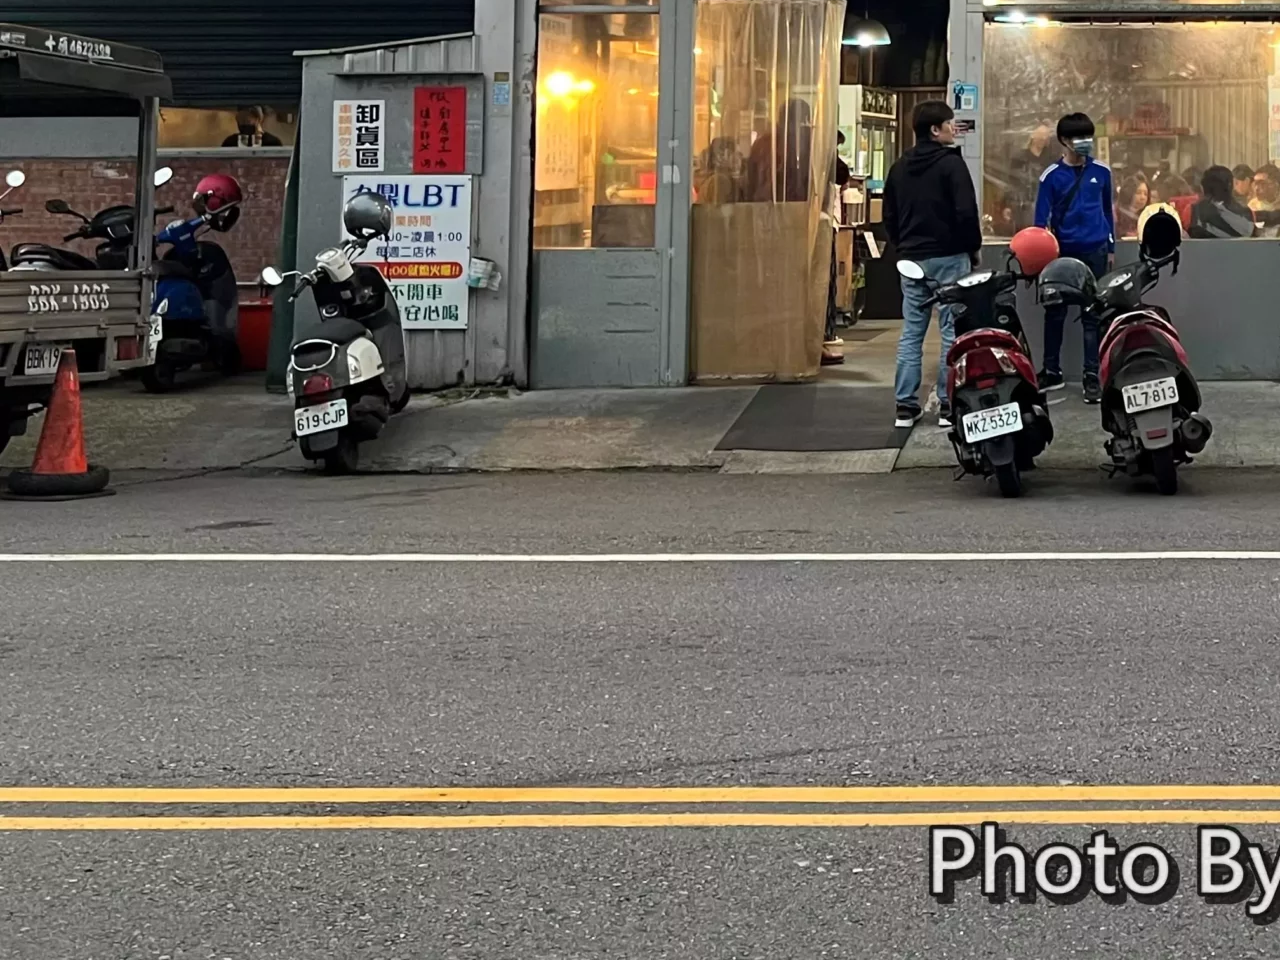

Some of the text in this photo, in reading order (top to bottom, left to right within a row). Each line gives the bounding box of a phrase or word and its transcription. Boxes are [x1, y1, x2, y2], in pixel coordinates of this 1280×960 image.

[356, 104, 380, 168] 卸貨區
[394, 215, 432, 227] 業時間
[398, 305, 459, 322] 安心喝
